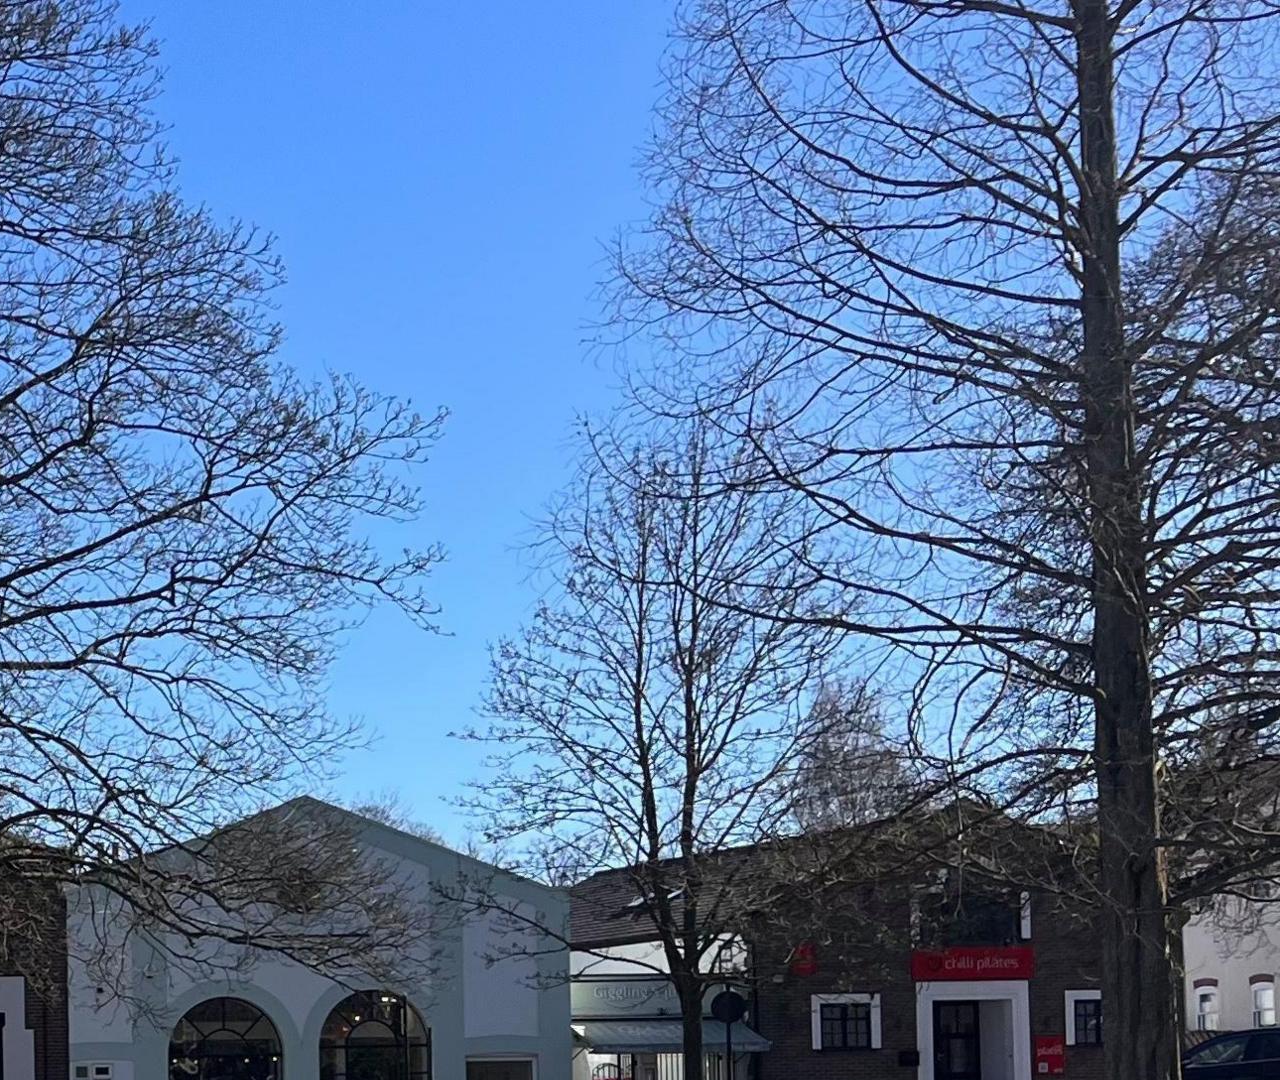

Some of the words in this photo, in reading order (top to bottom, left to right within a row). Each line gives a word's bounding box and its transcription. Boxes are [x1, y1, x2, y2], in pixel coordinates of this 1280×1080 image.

[944, 956, 974, 969] chilli
[976, 957, 1020, 971] pilates
[593, 985, 648, 1001] Giggling
